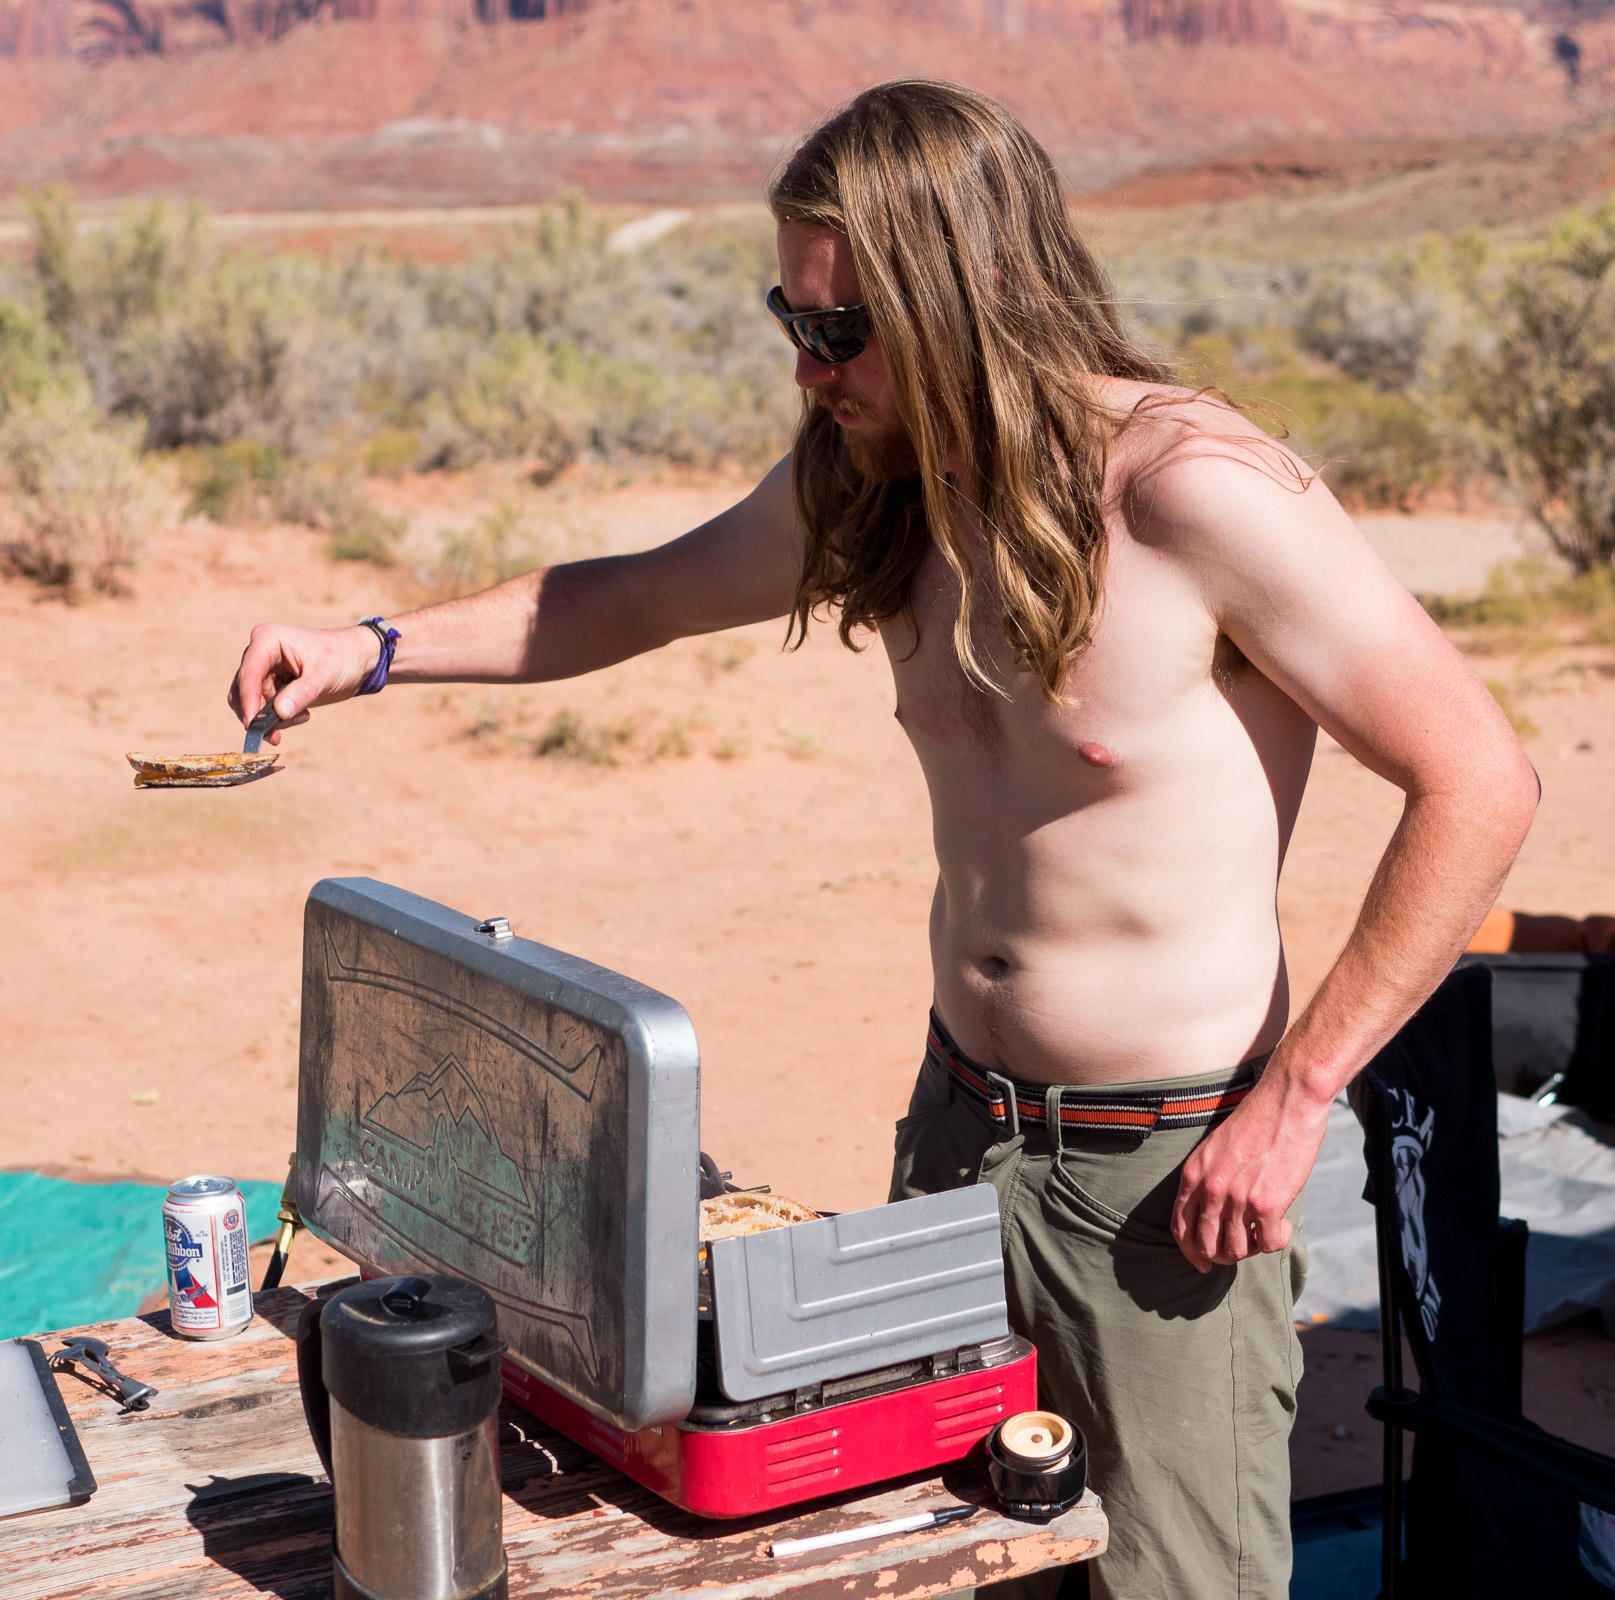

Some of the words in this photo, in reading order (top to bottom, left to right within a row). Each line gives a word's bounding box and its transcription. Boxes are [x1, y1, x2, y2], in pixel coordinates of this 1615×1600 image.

[361, 1135, 425, 1192] CAMP
[458, 1191, 531, 1251] CHEF
[166, 1238, 201, 1258] Ribbon
